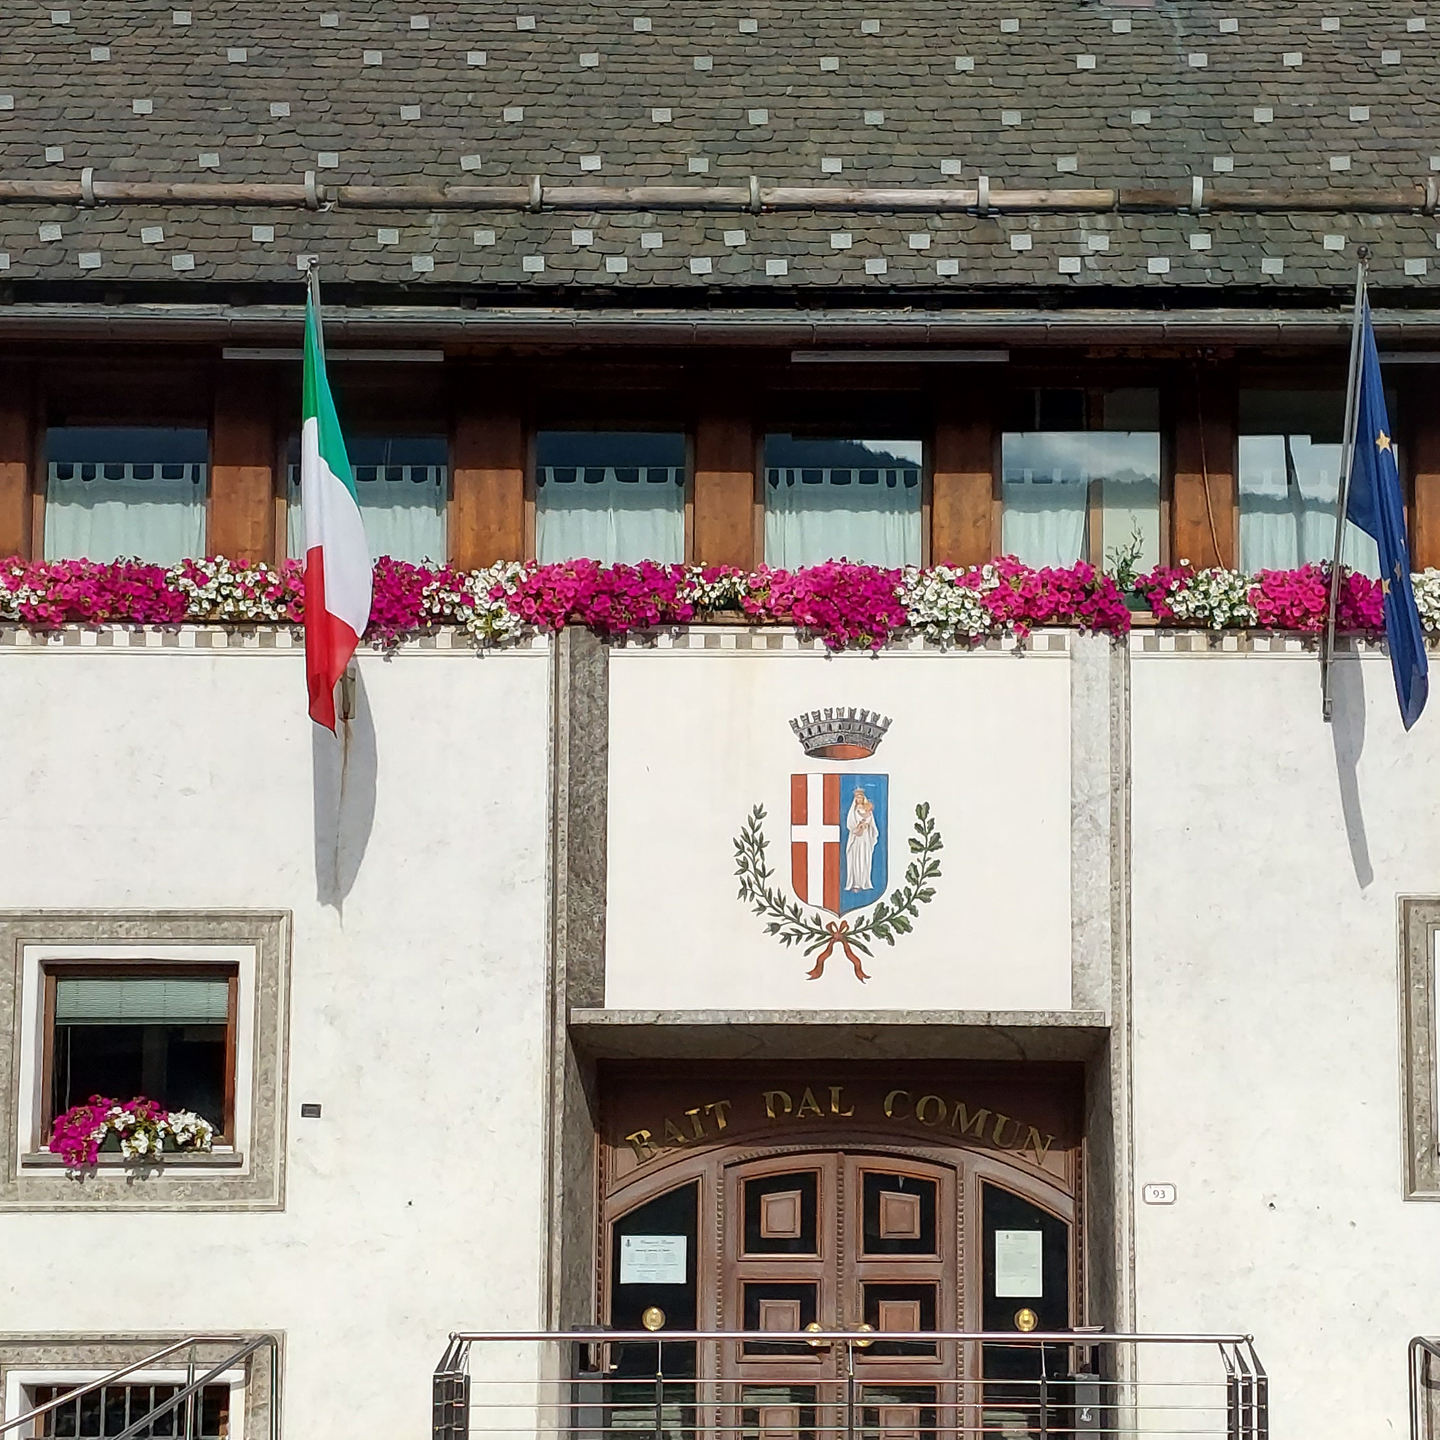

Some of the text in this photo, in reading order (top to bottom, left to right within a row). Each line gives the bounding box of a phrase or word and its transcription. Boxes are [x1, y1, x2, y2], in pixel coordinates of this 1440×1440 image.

[763, 1086, 855, 1119] DAL
[884, 1090, 1057, 1165] COMUN
[1153, 1189, 1166, 1199] 93
